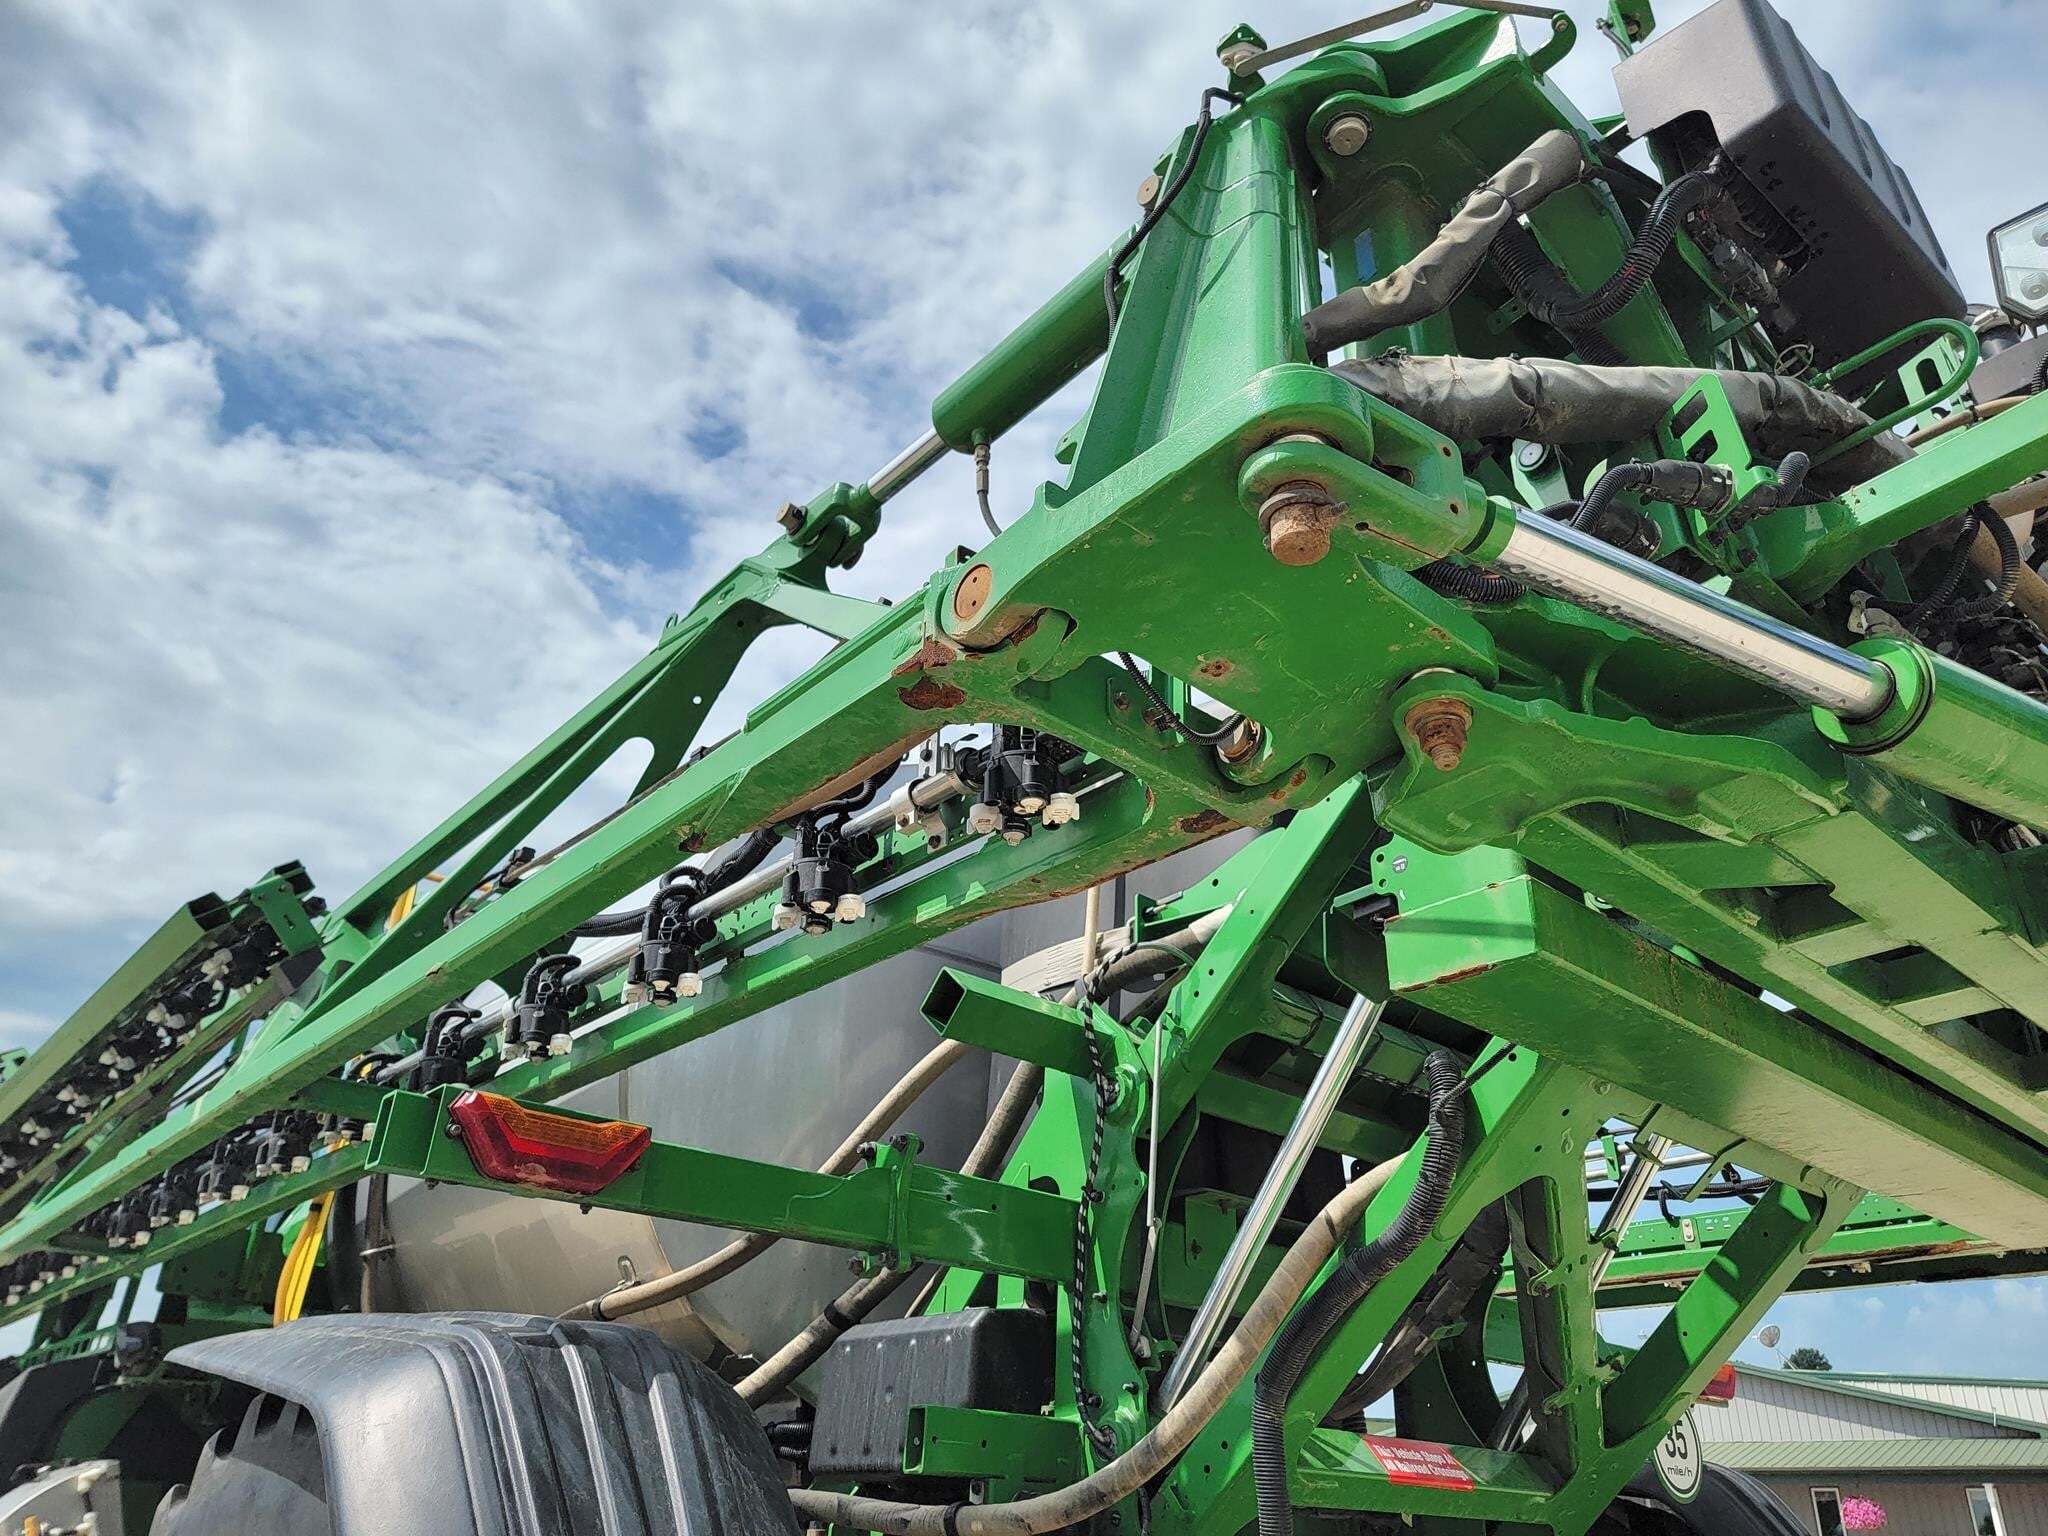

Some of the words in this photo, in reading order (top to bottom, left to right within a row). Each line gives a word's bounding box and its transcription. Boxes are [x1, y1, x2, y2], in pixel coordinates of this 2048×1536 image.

[1665, 1419, 1688, 1460] 35
[1373, 1444, 1395, 1457] This
[1390, 1446, 1421, 1460] Vehicle
[1383, 1458, 1399, 1471] All
[1393, 1459, 1432, 1474] Railroad
[1667, 1466, 1693, 1477] mile/h
